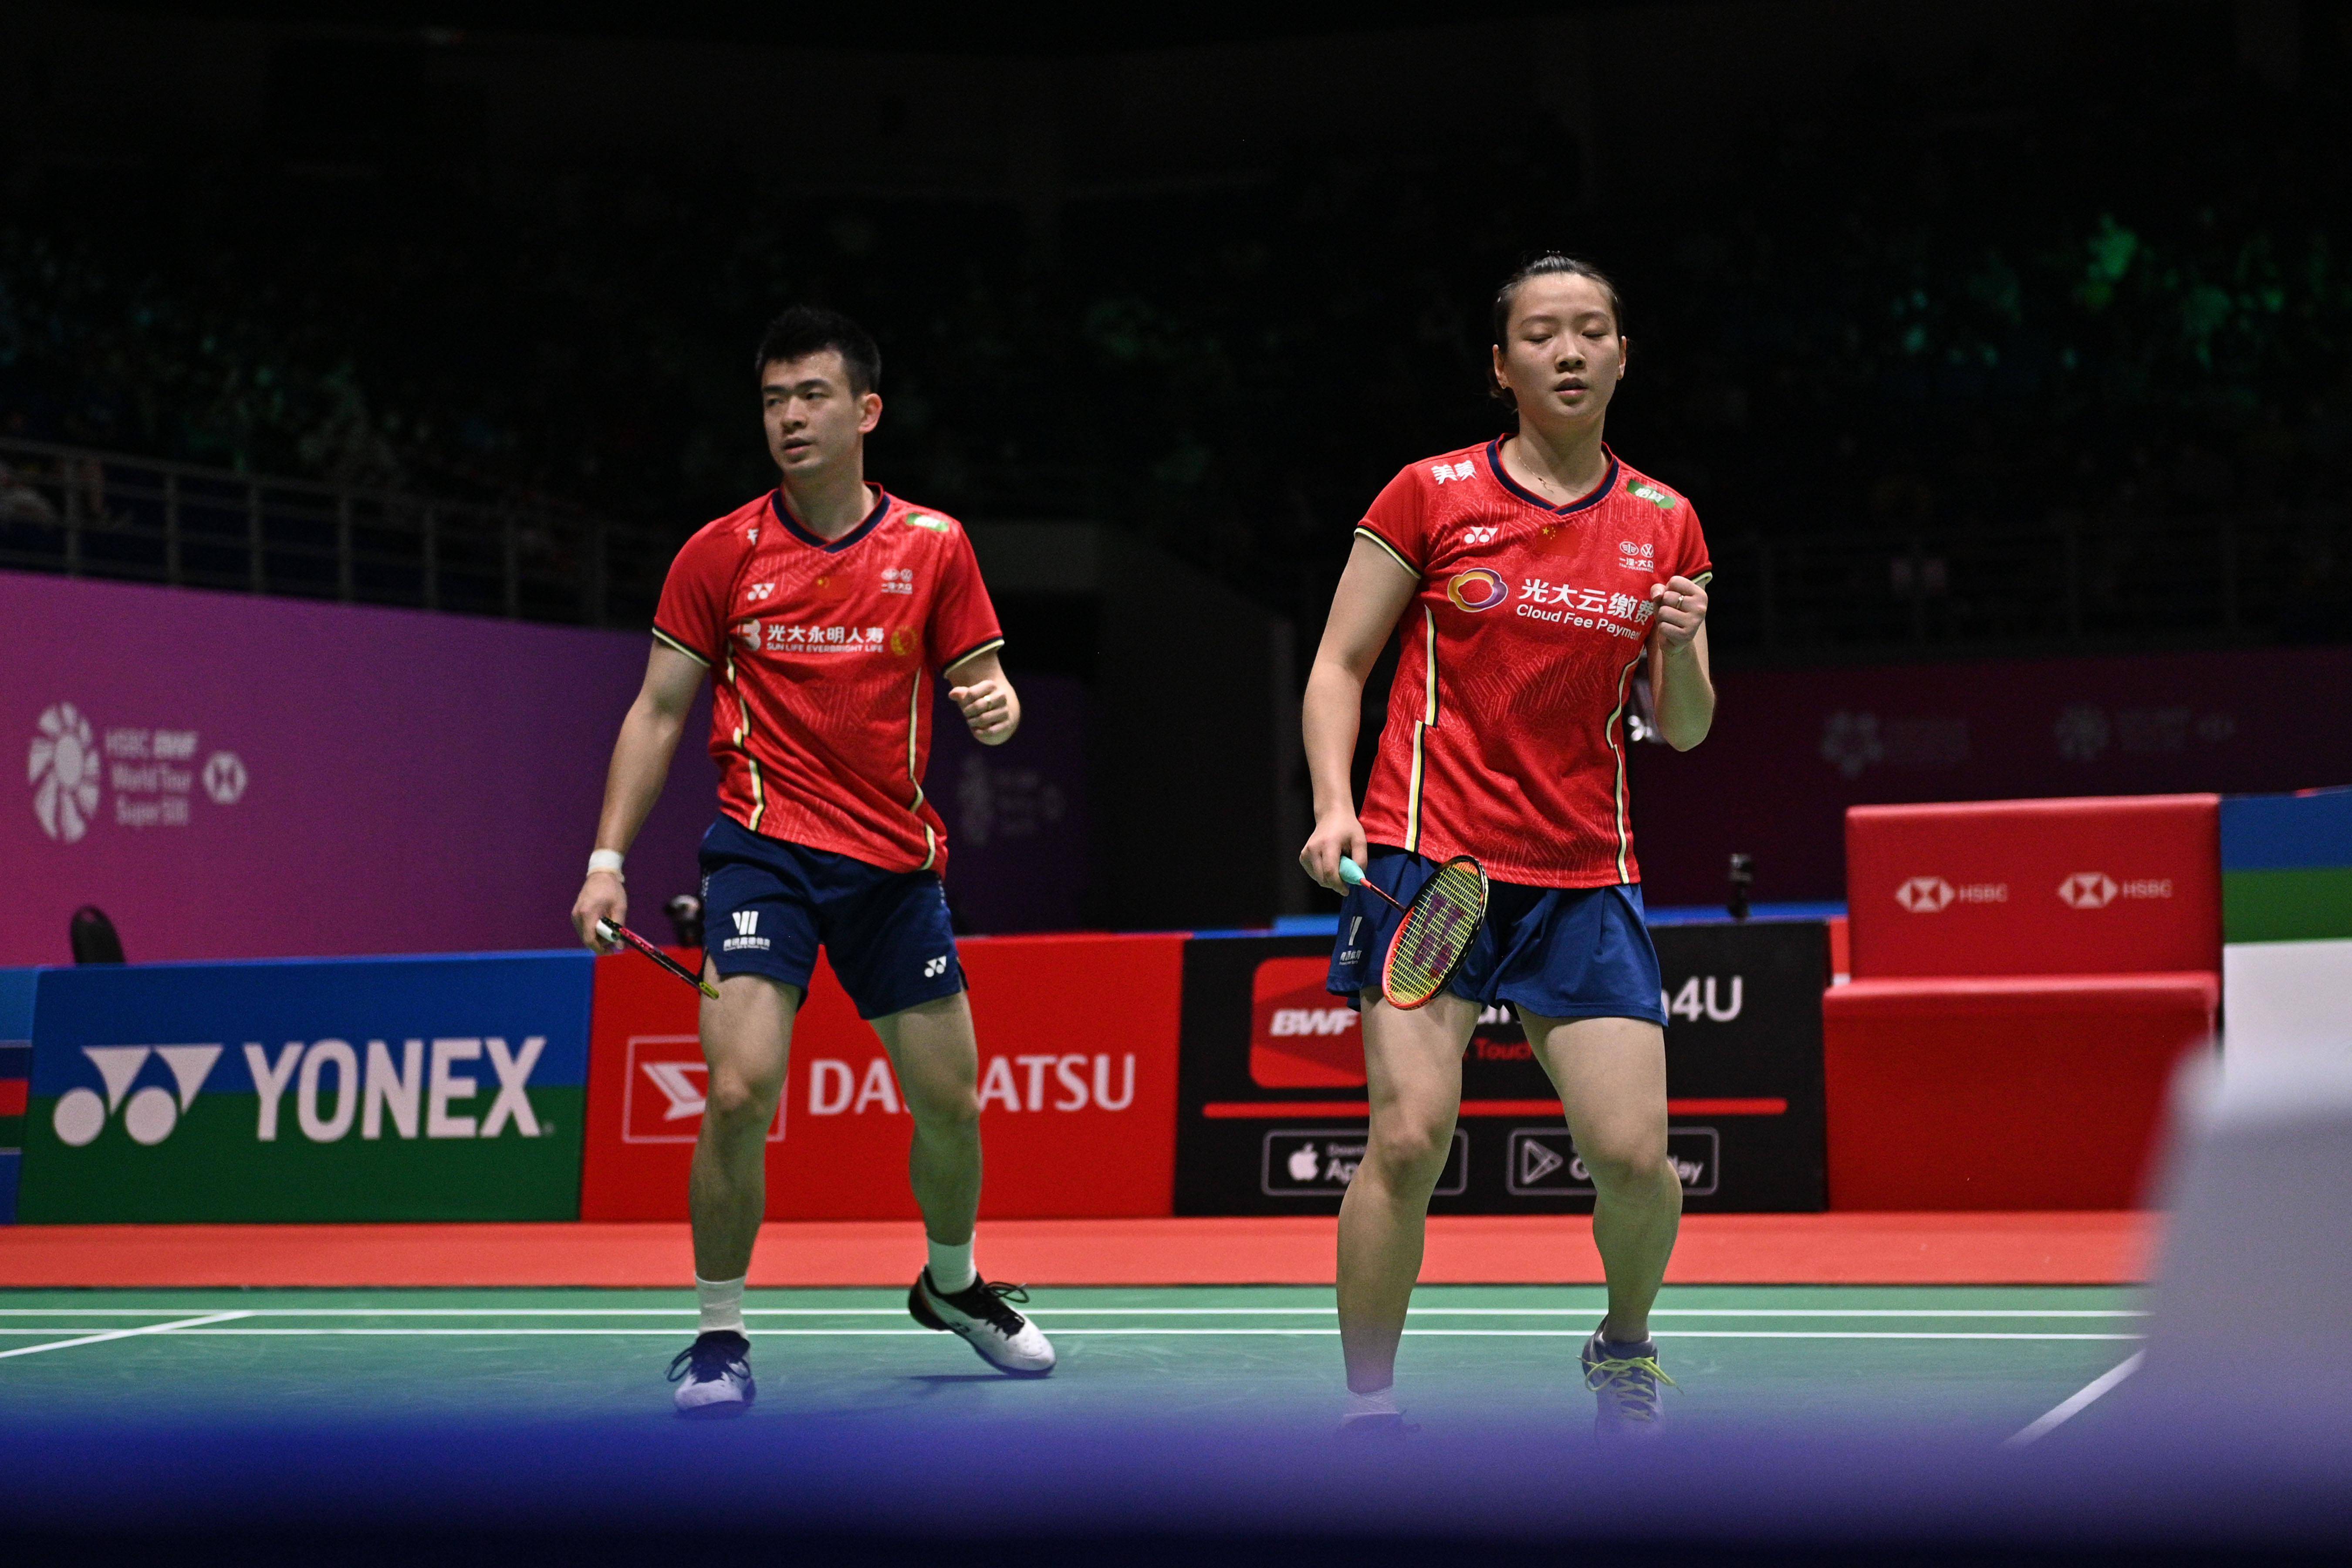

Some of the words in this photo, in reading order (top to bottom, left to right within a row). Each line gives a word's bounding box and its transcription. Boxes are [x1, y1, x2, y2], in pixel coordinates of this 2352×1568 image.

[1518, 579, 1654, 625] 光大云缴费
[1517, 604, 1562, 623] Cloud
[1563, 612, 1593, 628] Fee
[767, 624, 884, 644] 光大永明人寿
[767, 642, 784, 651] SUN
[785, 643, 804, 652] LIFE
[806, 644, 863, 653] EVERBRIGHT
[865, 643, 884, 653] LIFE
[1960, 882, 2008, 903] HSBC
[2122, 878, 2173, 899] HSBC
[1269, 1008, 1360, 1036] BWF
[241, 1035, 547, 1143] YONEX
[808, 1053, 1136, 1116] DAATSU
